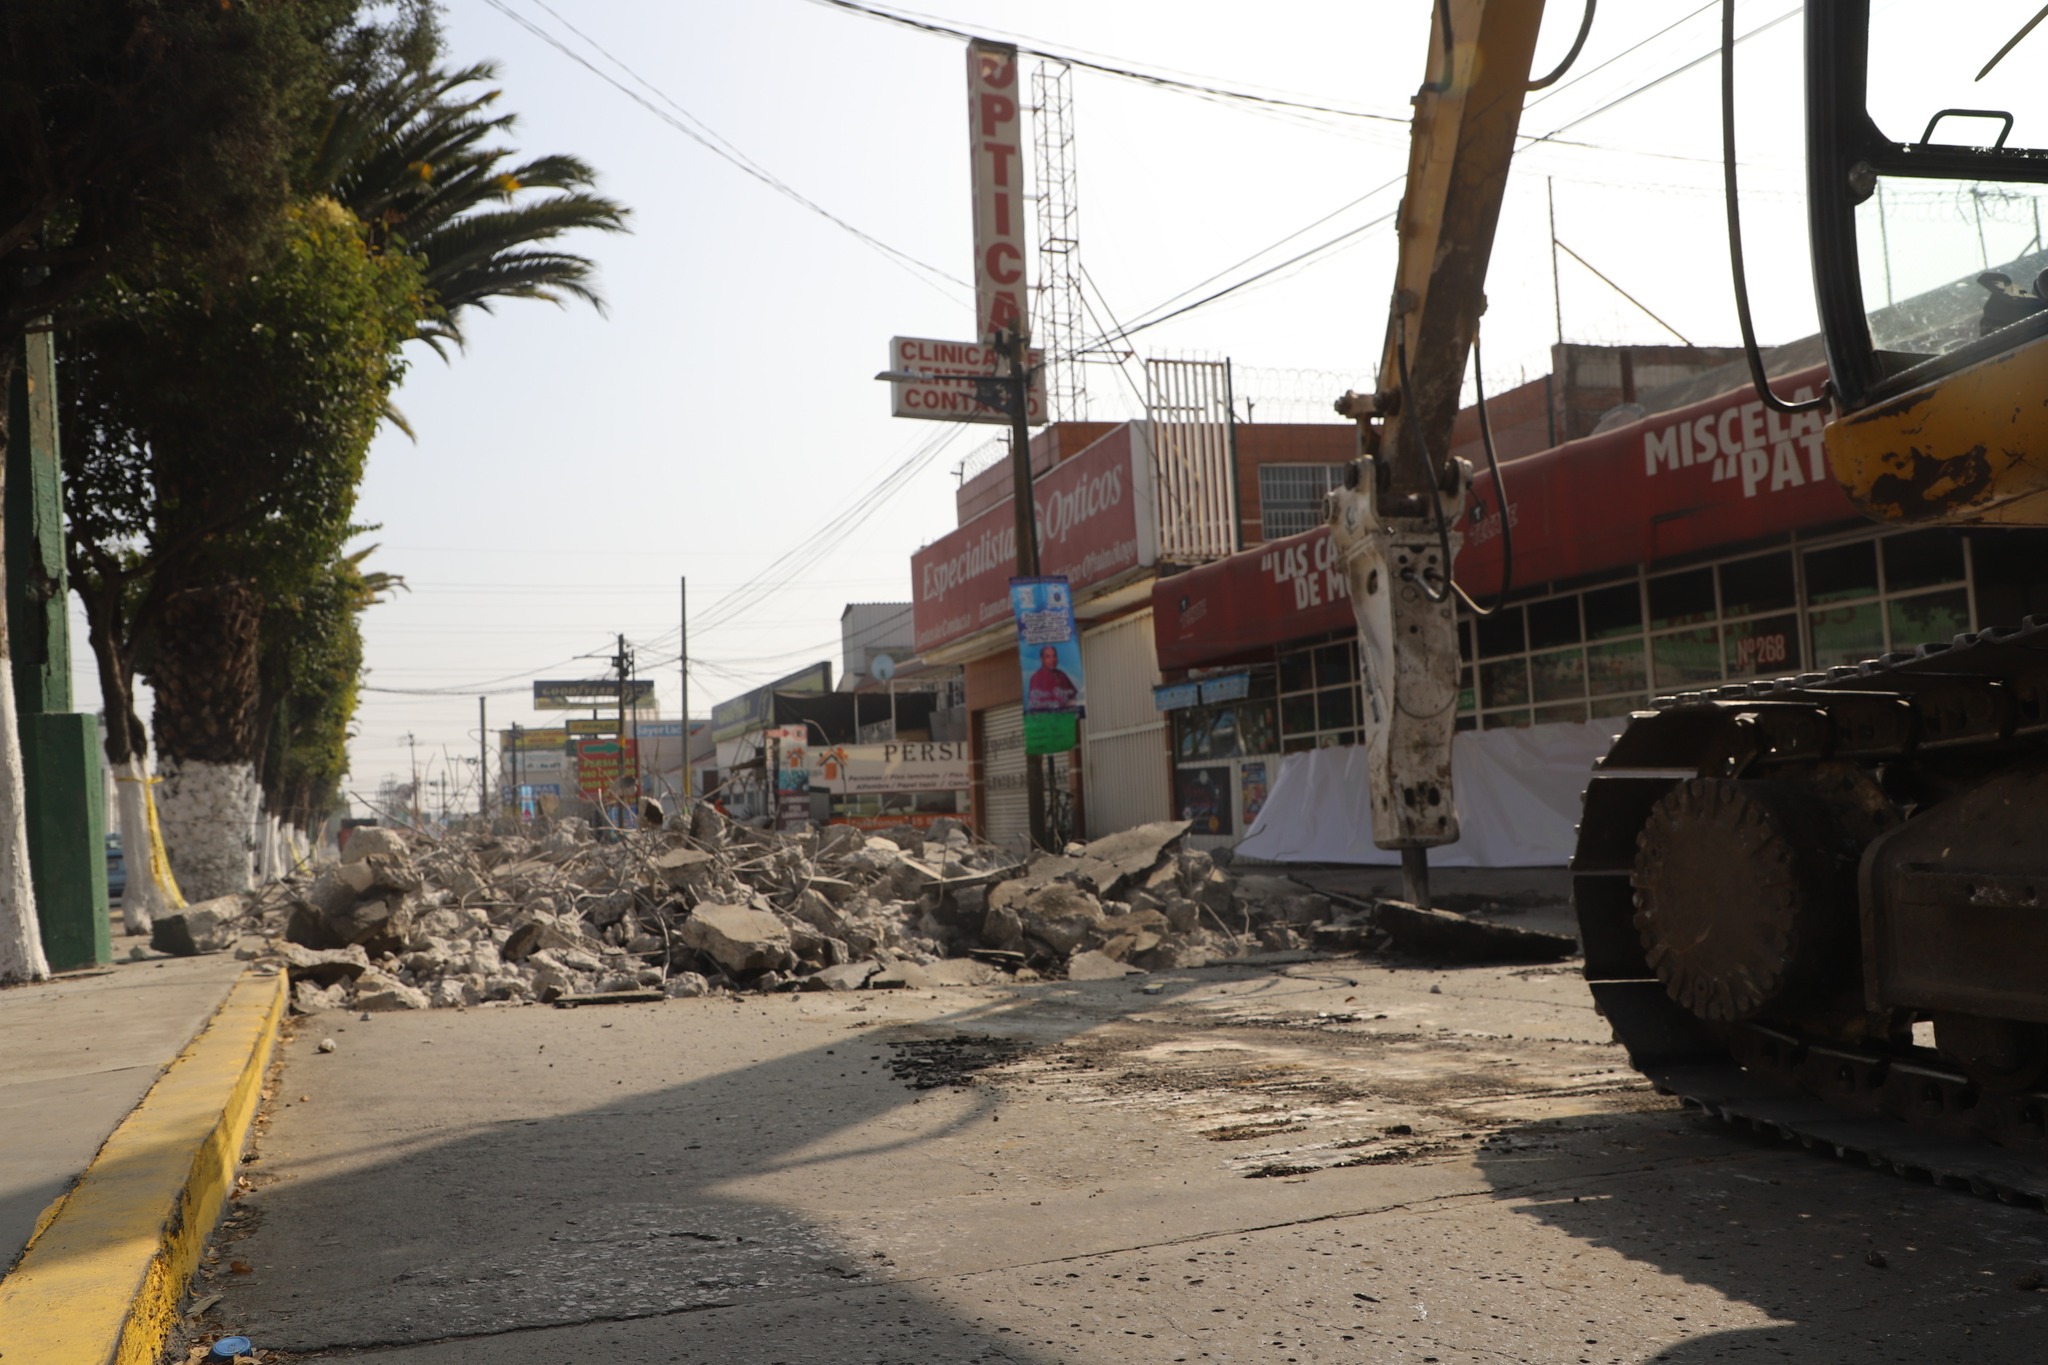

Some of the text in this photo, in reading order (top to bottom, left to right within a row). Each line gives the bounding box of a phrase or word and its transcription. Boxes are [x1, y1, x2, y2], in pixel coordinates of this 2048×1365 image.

[900, 341, 997, 366] CLINICA
[1295, 571, 1322, 610] DE
[884, 742, 963, 763] PERSI
